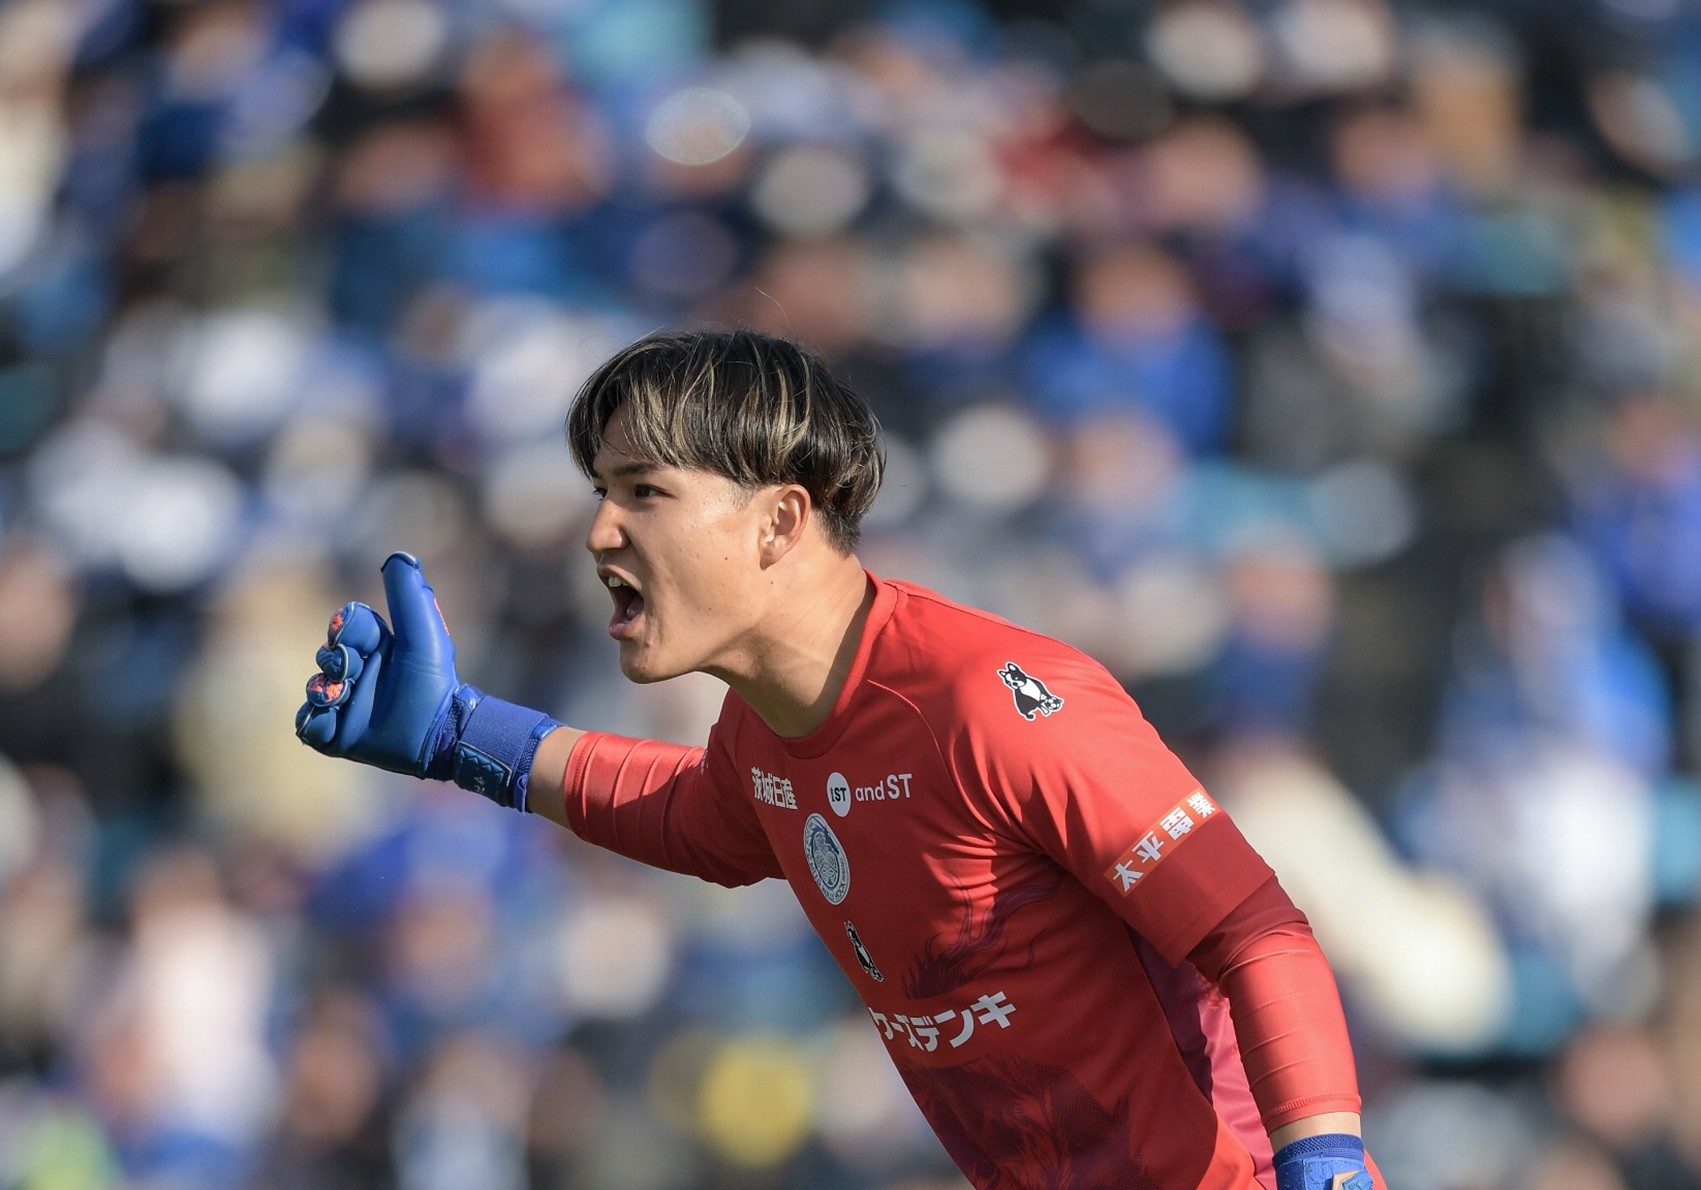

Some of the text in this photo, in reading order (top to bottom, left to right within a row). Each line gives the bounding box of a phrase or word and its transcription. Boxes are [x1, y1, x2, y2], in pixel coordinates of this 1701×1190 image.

[751, 766, 798, 810] 茨城日産
[855, 773, 913, 802] and ST
[1112, 791, 1217, 893] 太平電業
